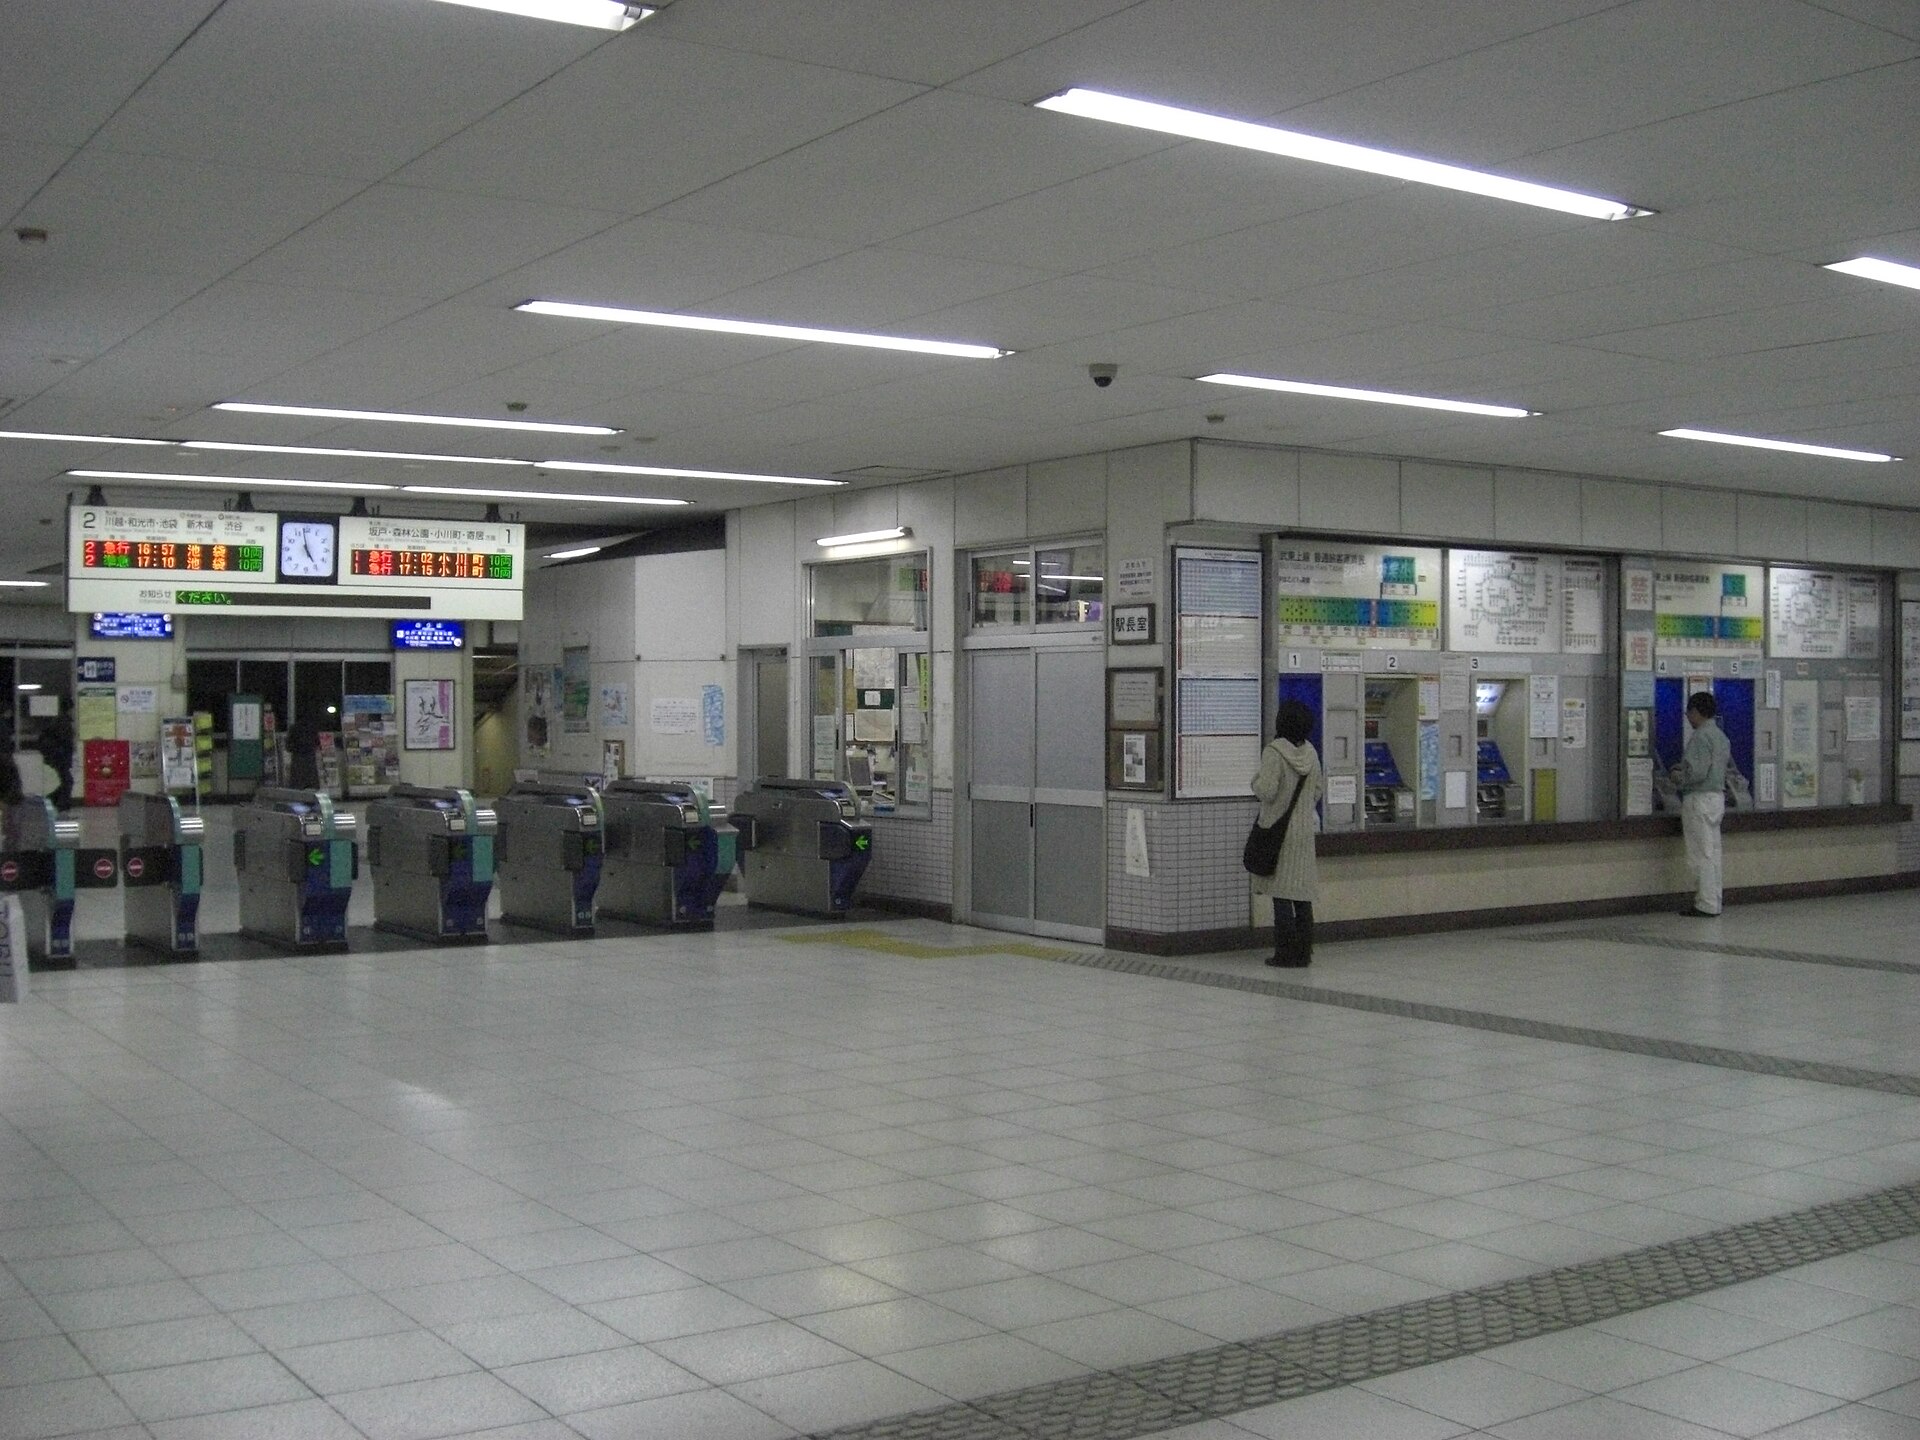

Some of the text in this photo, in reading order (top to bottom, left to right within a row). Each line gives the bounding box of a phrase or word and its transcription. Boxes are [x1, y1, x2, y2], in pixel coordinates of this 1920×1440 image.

[83, 512, 96, 528] 2
[187, 519, 213, 530] 新木場
[224, 521, 243, 531] 渋谷
[505, 529, 511, 544] 1
[85, 542, 95, 553] 2
[104, 543, 130, 554] 急行
[137, 543, 175, 555] 16:57
[239, 546, 262, 559] 10両
[85, 555, 95, 566] 2
[103, 556, 130, 568] 準急
[137, 556, 175, 568] 17:10
[239, 558, 262, 571] 10両
[354, 551, 359, 561] 1
[368, 551, 393, 562] 急行
[400, 552, 433, 564] 17:02
[489, 554, 512, 567] 10両
[354, 563, 359, 573] 1
[368, 563, 393, 575] 急行
[400, 564, 433, 576] 17:15
[489, 566, 512, 579] 10両
[139, 590, 172, 598] お知らせ
[177, 591, 232, 605] ください。
[1115, 616, 1147, 632] 駅長室
[1293, 655, 1297, 666] 1
[1389, 657, 1396, 668] 2
[1472, 659, 1479, 669] 3
[1660, 662, 1665, 671] 4
[1732, 663, 1738, 672] 5
